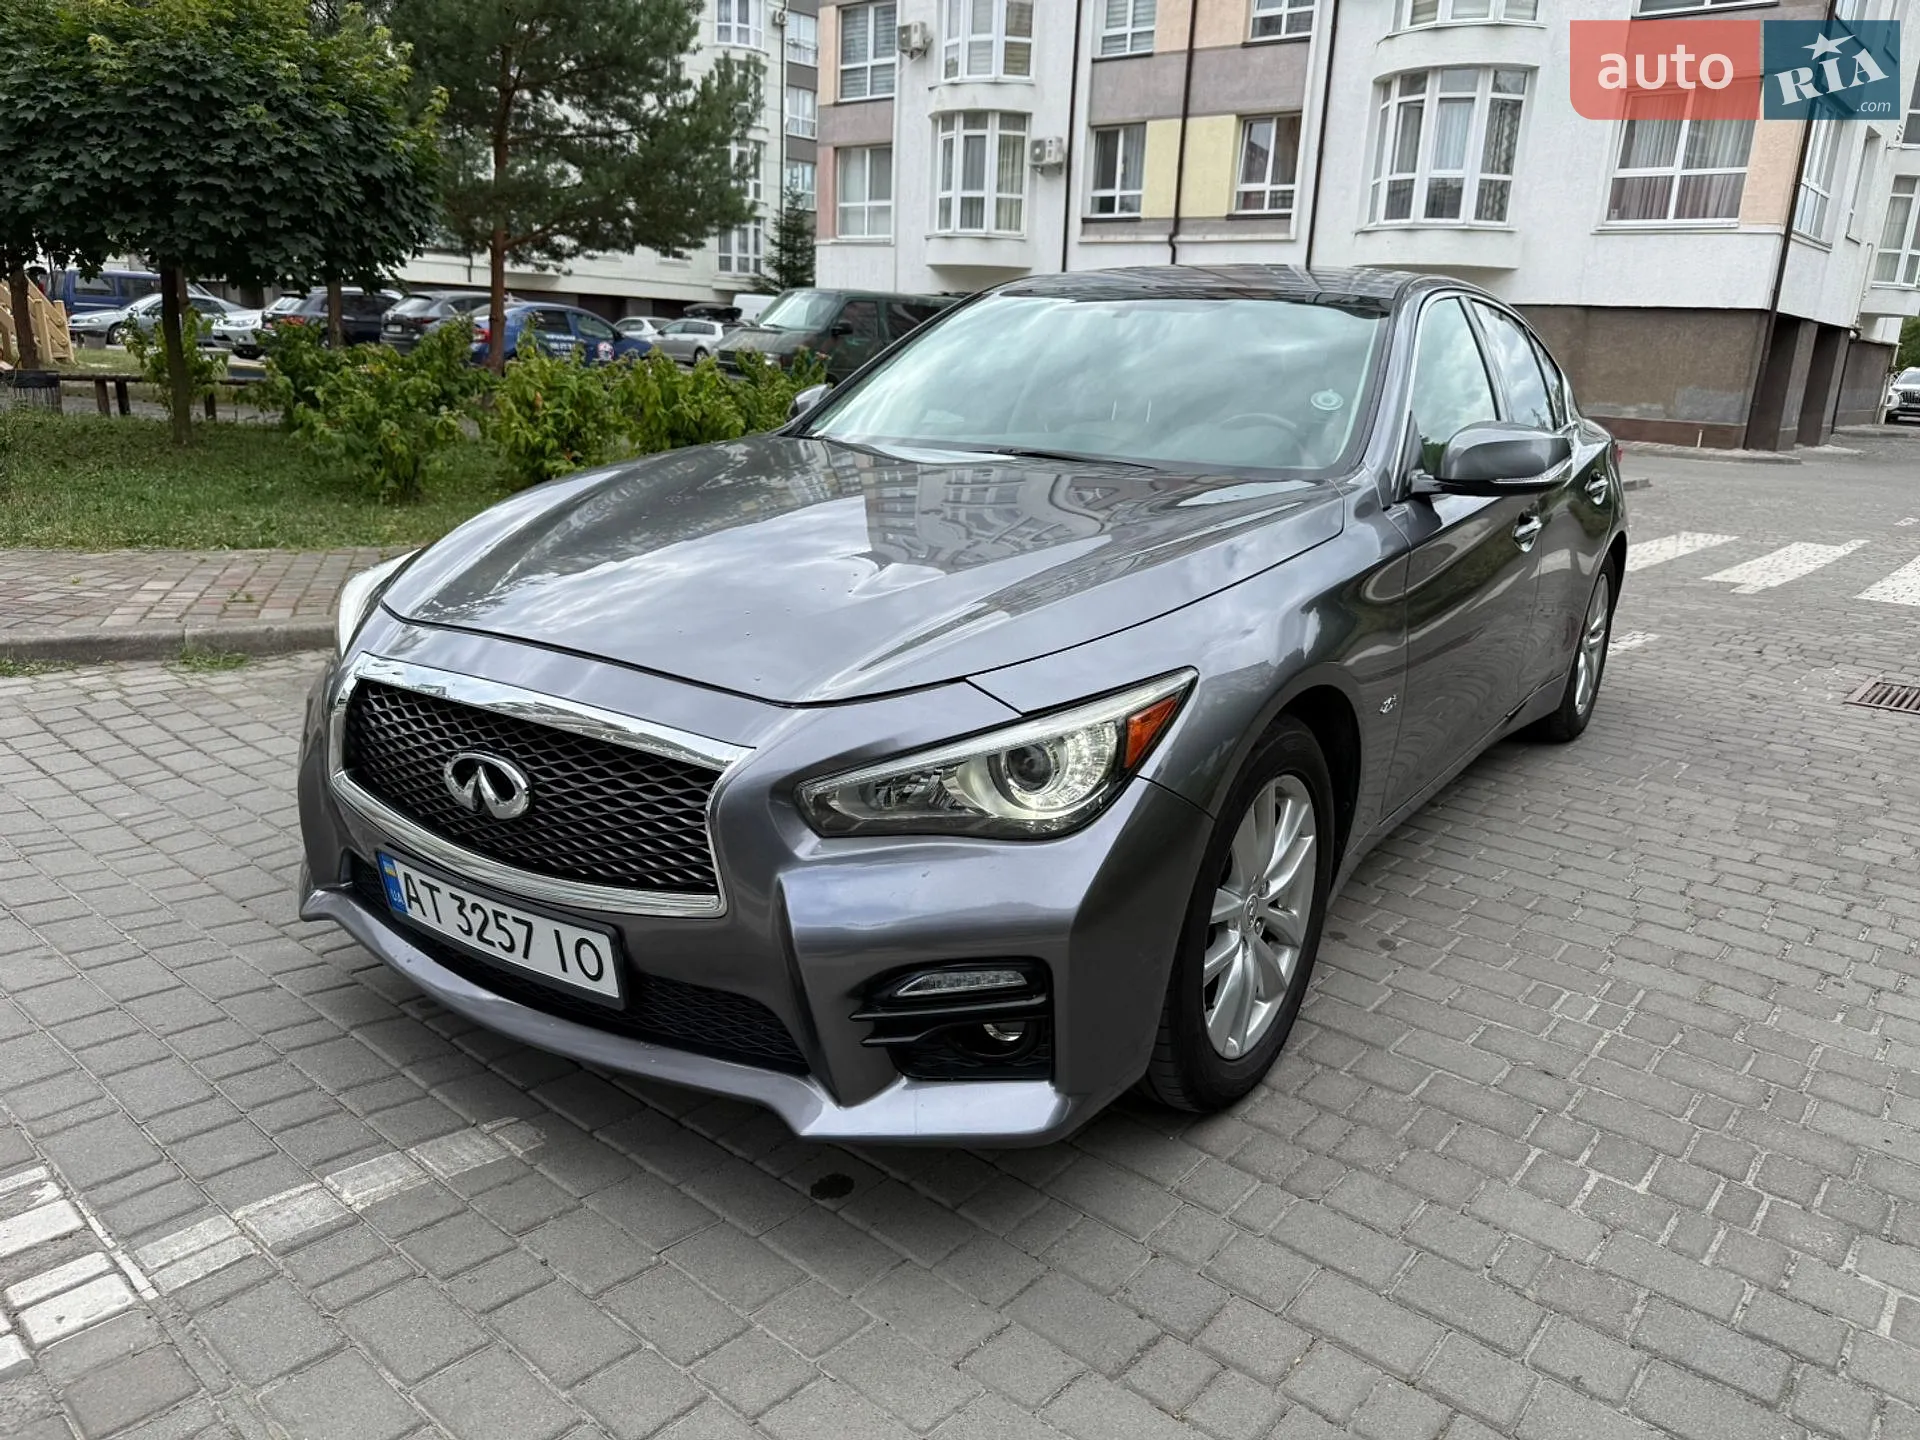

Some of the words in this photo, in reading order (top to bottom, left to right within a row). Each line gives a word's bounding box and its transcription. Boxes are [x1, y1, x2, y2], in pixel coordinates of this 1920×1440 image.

[403, 871, 443, 925] AT
[449, 893, 534, 960] 3257
[554, 929, 604, 982] IO
